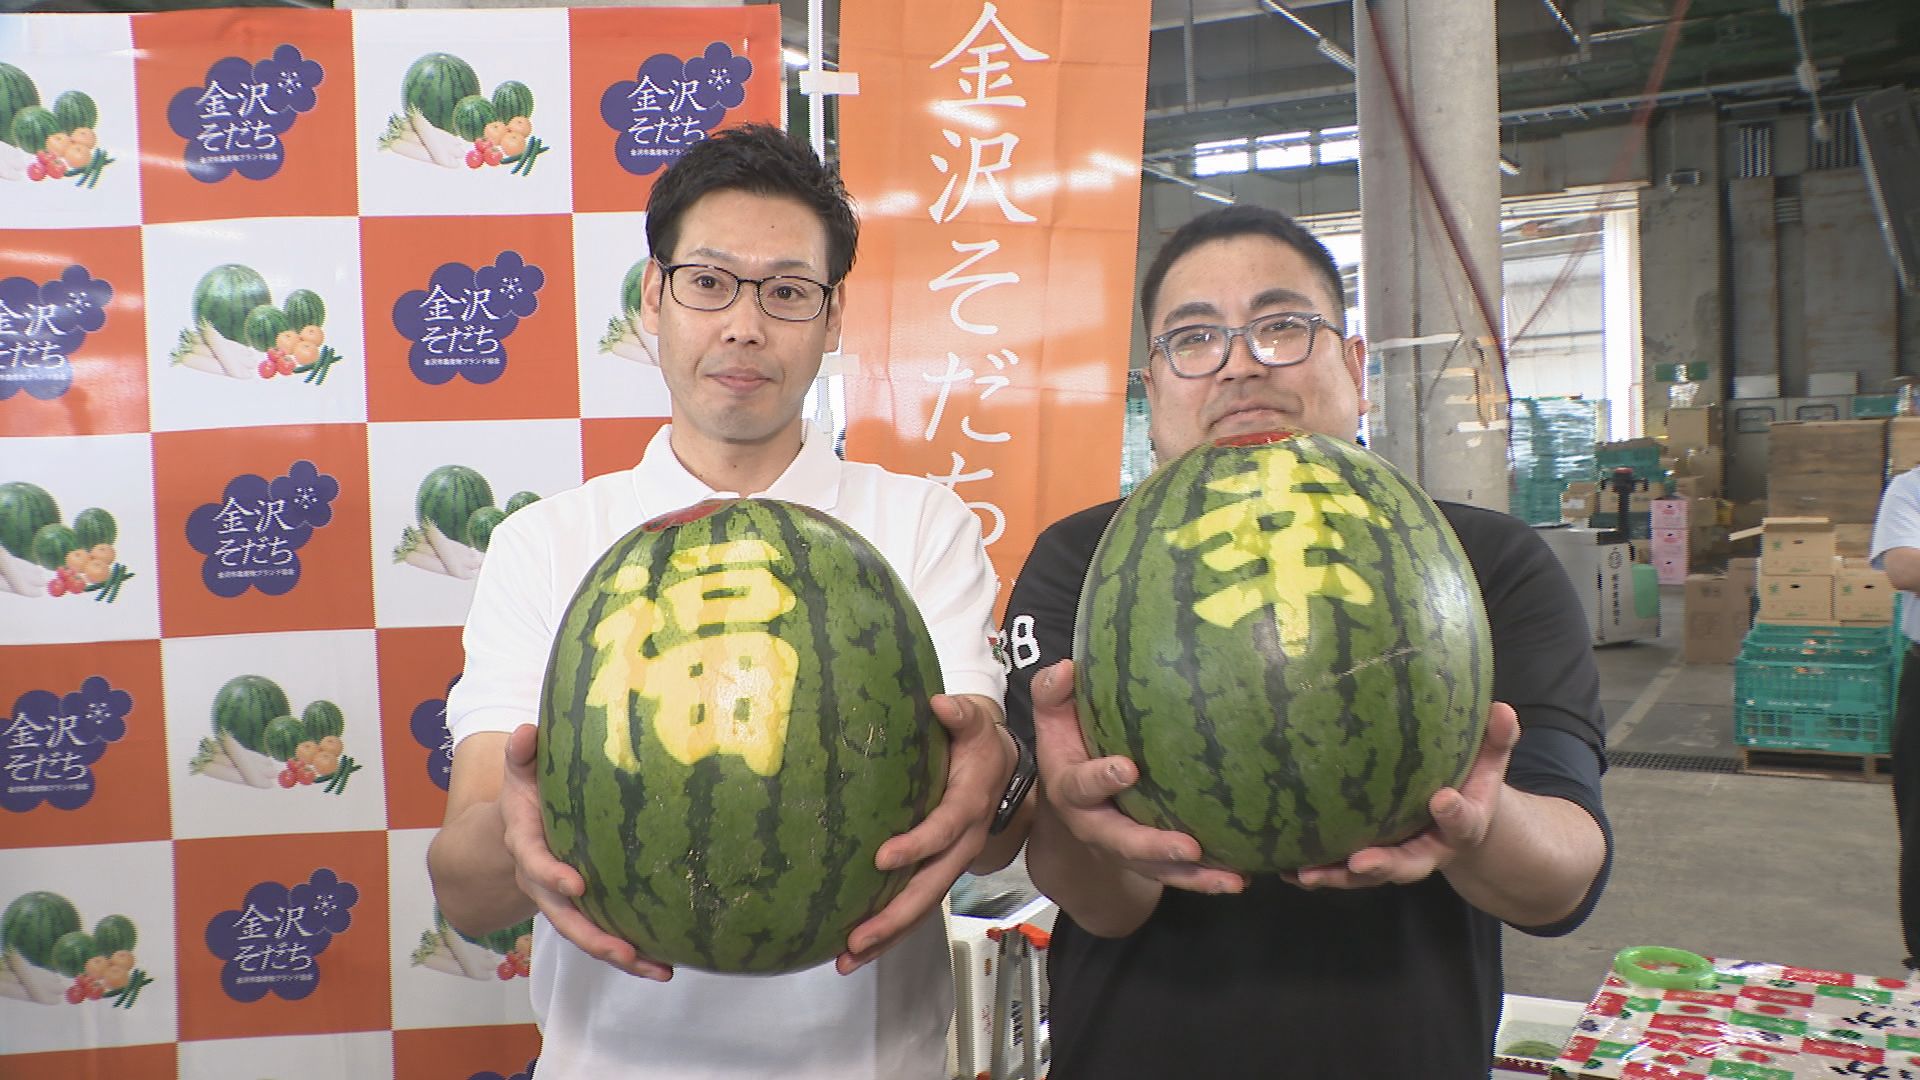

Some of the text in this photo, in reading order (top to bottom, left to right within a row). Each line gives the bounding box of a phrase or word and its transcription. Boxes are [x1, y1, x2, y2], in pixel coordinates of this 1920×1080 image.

[194, 80, 278, 117] 金沢
[627, 74, 707, 113] 金沢
[196, 120, 277, 151] そだち
[628, 116, 705, 145] そだち
[418, 284, 501, 321] 金沢
[420, 324, 499, 354] そだち
[213, 497, 295, 533] 金沢
[214, 536, 293, 566] そだち
[1164, 448, 1392, 657] 幸
[584, 538, 800, 777] 福
[0, 712, 87, 748] 金沢
[3, 751, 88, 781] そだち
[232, 904, 313, 939] 金沢
[233, 942, 312, 972] そだち
